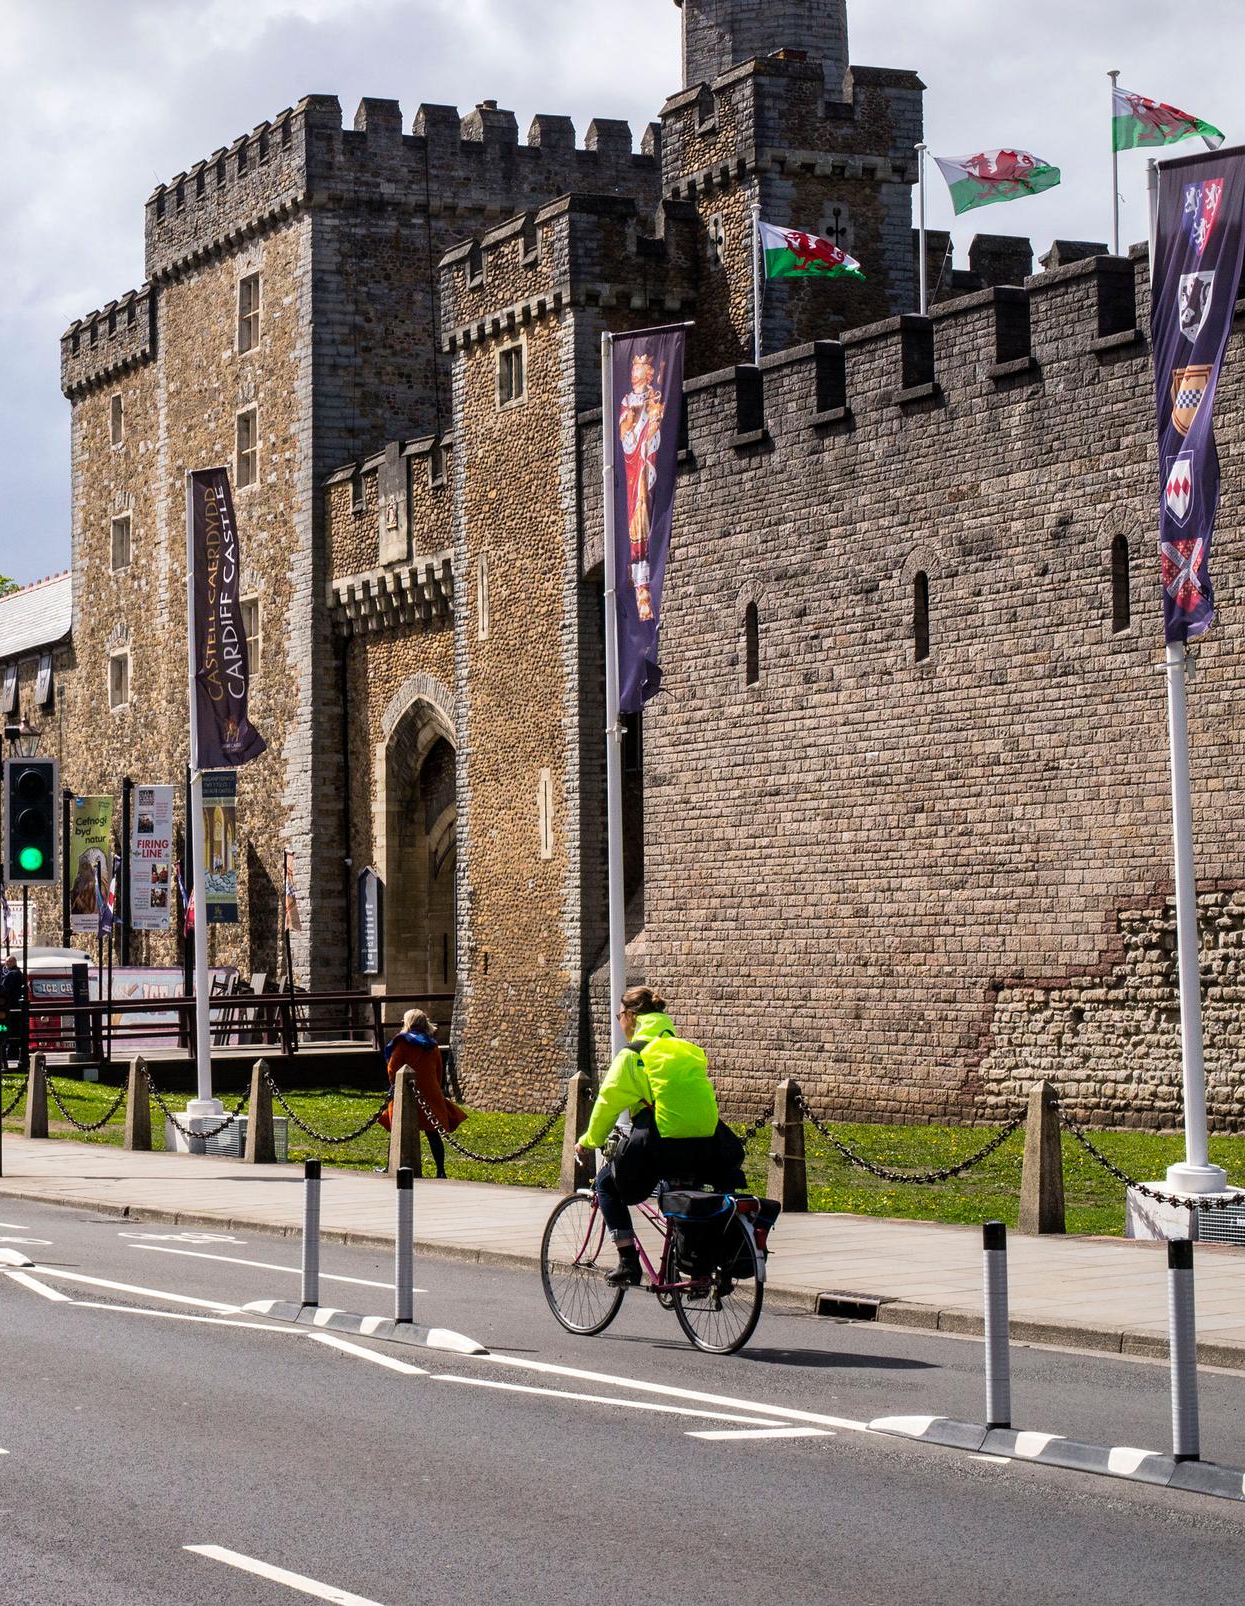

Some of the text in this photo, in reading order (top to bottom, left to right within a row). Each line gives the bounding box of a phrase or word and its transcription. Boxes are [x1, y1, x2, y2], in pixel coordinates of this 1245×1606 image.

[203, 487, 224, 702] CASTELL CAERDYDD
[214, 485, 247, 700] CARDIFF CASTLE
[75, 815, 108, 827] Cefnogi
[75, 827, 92, 838] byd
[84, 835, 107, 844] natur
[137, 839, 169, 849] FIRING
[142, 849, 162, 858] LINE
[41, 983, 57, 992] ICE
